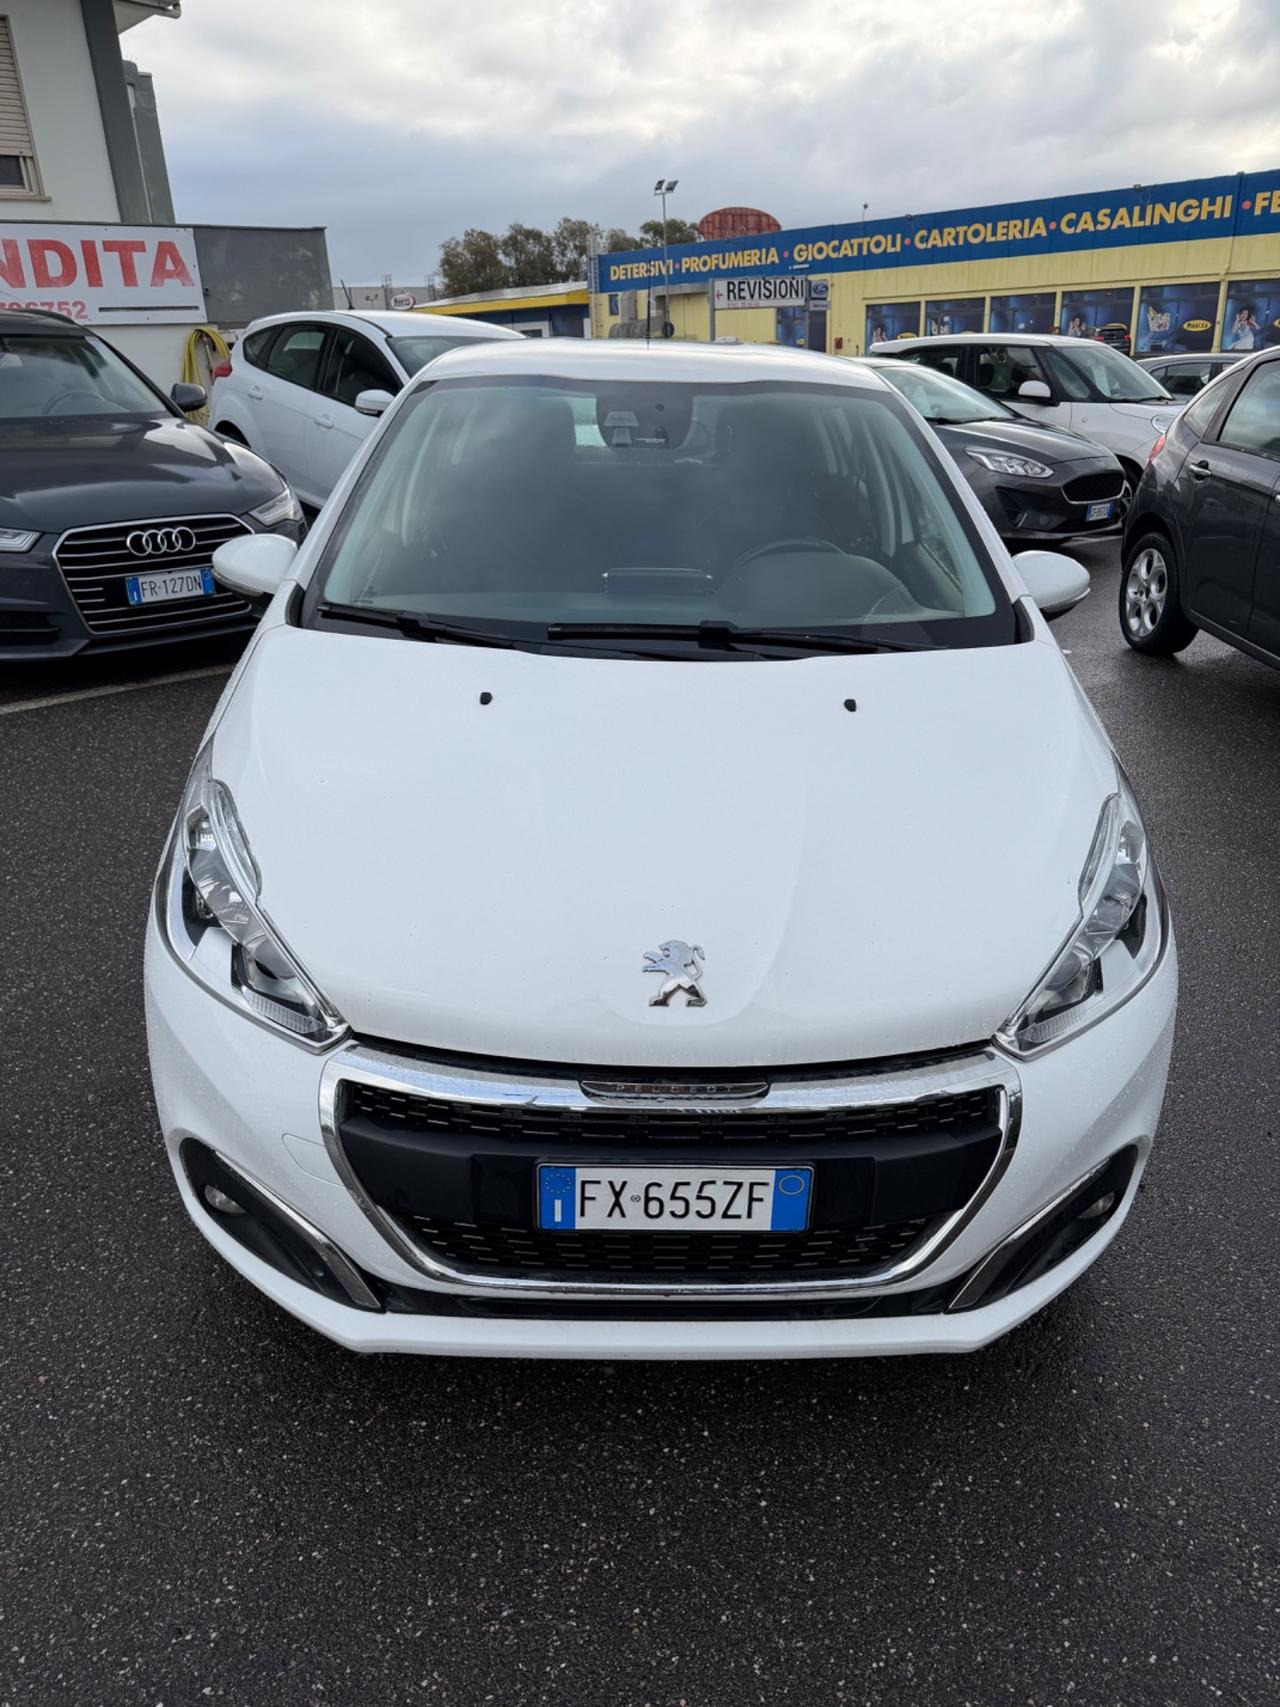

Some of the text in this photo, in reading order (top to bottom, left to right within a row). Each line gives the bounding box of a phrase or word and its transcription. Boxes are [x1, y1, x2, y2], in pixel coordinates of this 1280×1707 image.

[610, 259, 673, 281] DETERSIVI
[682, 247, 779, 273] PROFUMERIA
[793, 233, 901, 263] GIOCATTOLI
[914, 216, 1048, 250] CARTOLERIA
[1060, 195, 1233, 234] CASALINGHI
[726, 279, 804, 300] REVISIONI
[615, 1083, 734, 1093] PEUGEOT
